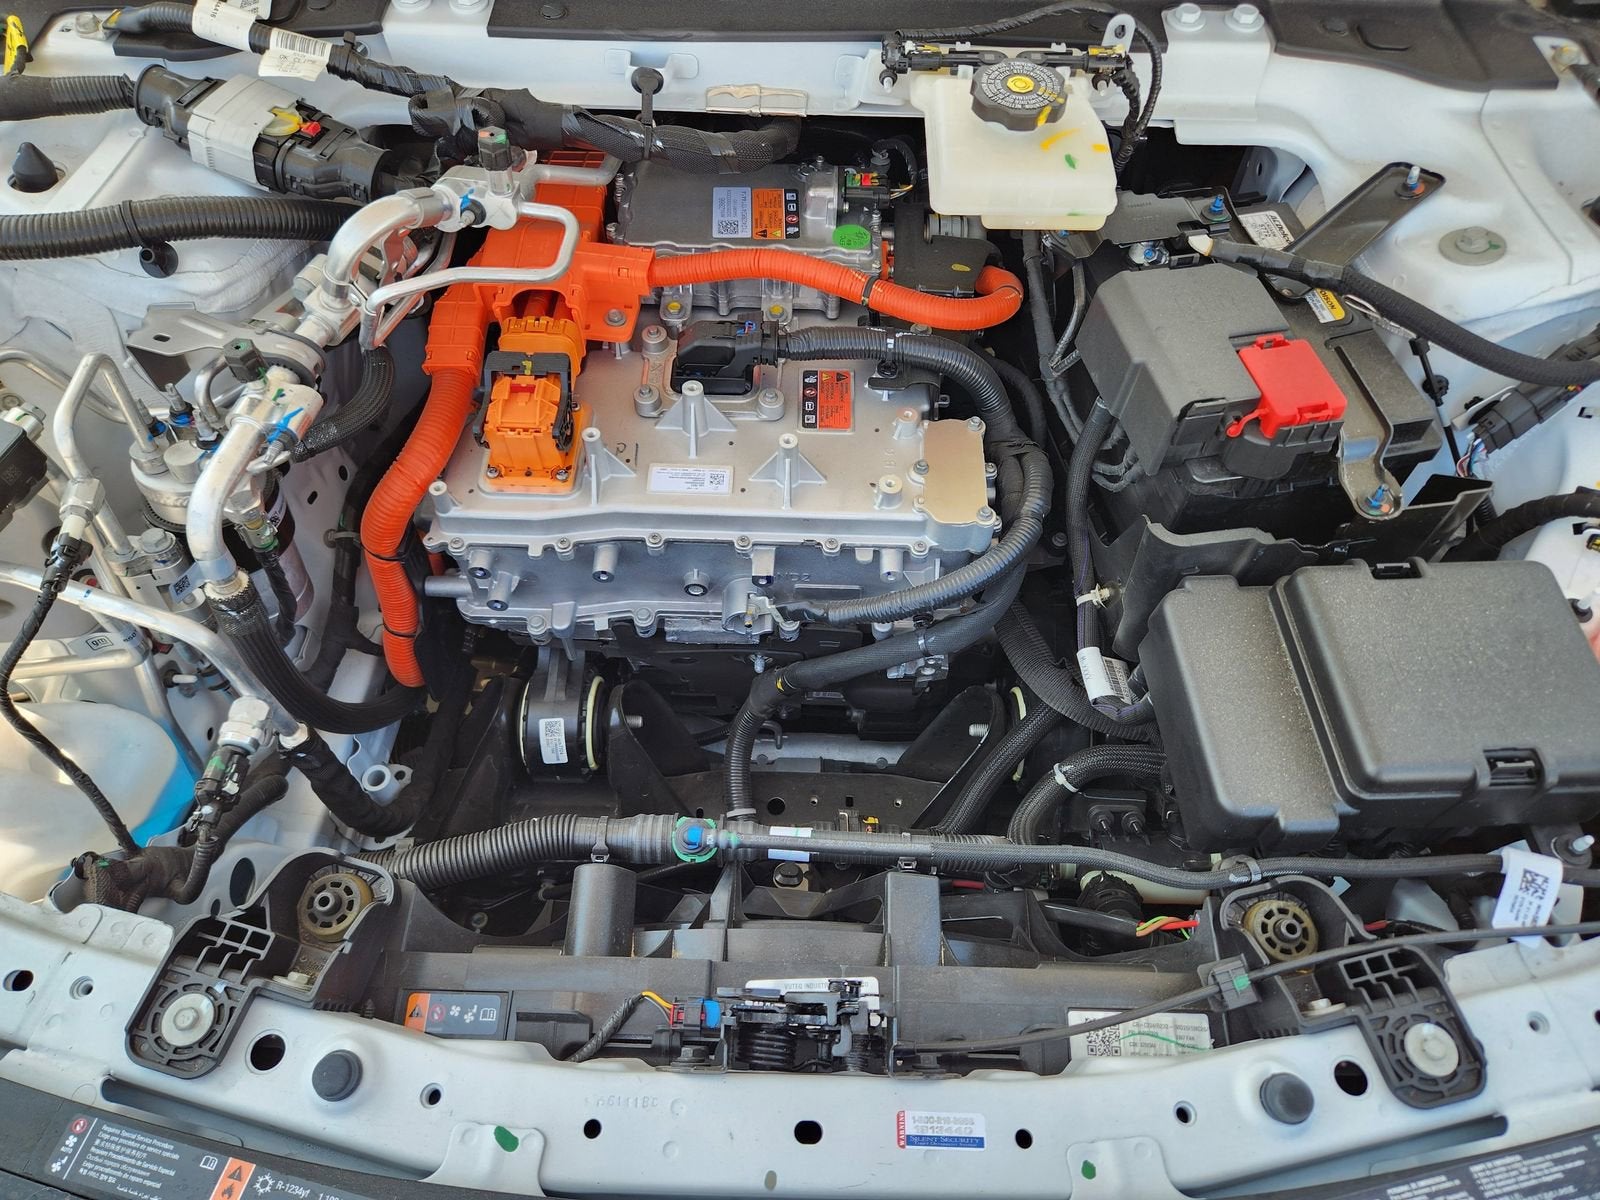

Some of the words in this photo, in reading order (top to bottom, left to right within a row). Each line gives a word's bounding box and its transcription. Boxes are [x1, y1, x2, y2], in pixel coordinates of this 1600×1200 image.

[909, 1135, 938, 1143] SILENT
[940, 1136, 981, 1144] SECURITY
[275, 1180, 311, 1199] R-1234yf
